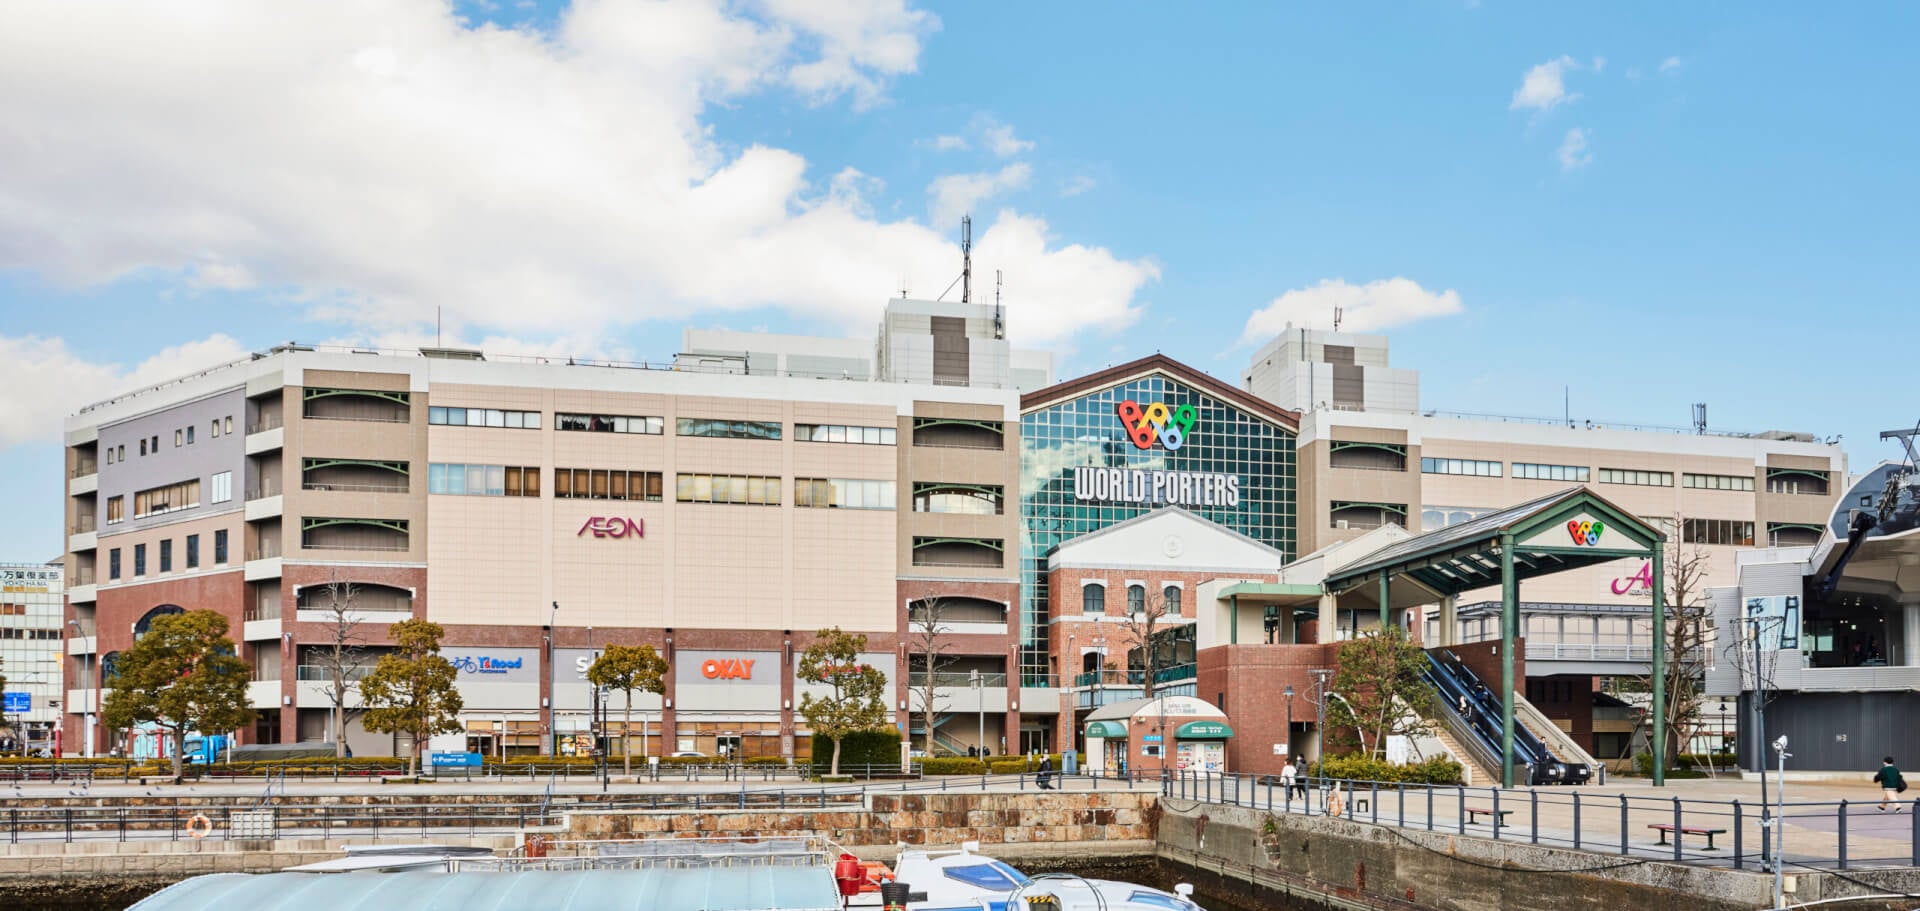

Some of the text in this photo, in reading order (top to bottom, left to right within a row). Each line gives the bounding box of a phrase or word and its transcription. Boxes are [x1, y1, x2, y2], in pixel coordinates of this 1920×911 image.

[1074, 467, 1240, 507] WORLD PORTERS
[491, 656, 523, 669] Road
[701, 658, 756, 680] OKAY
